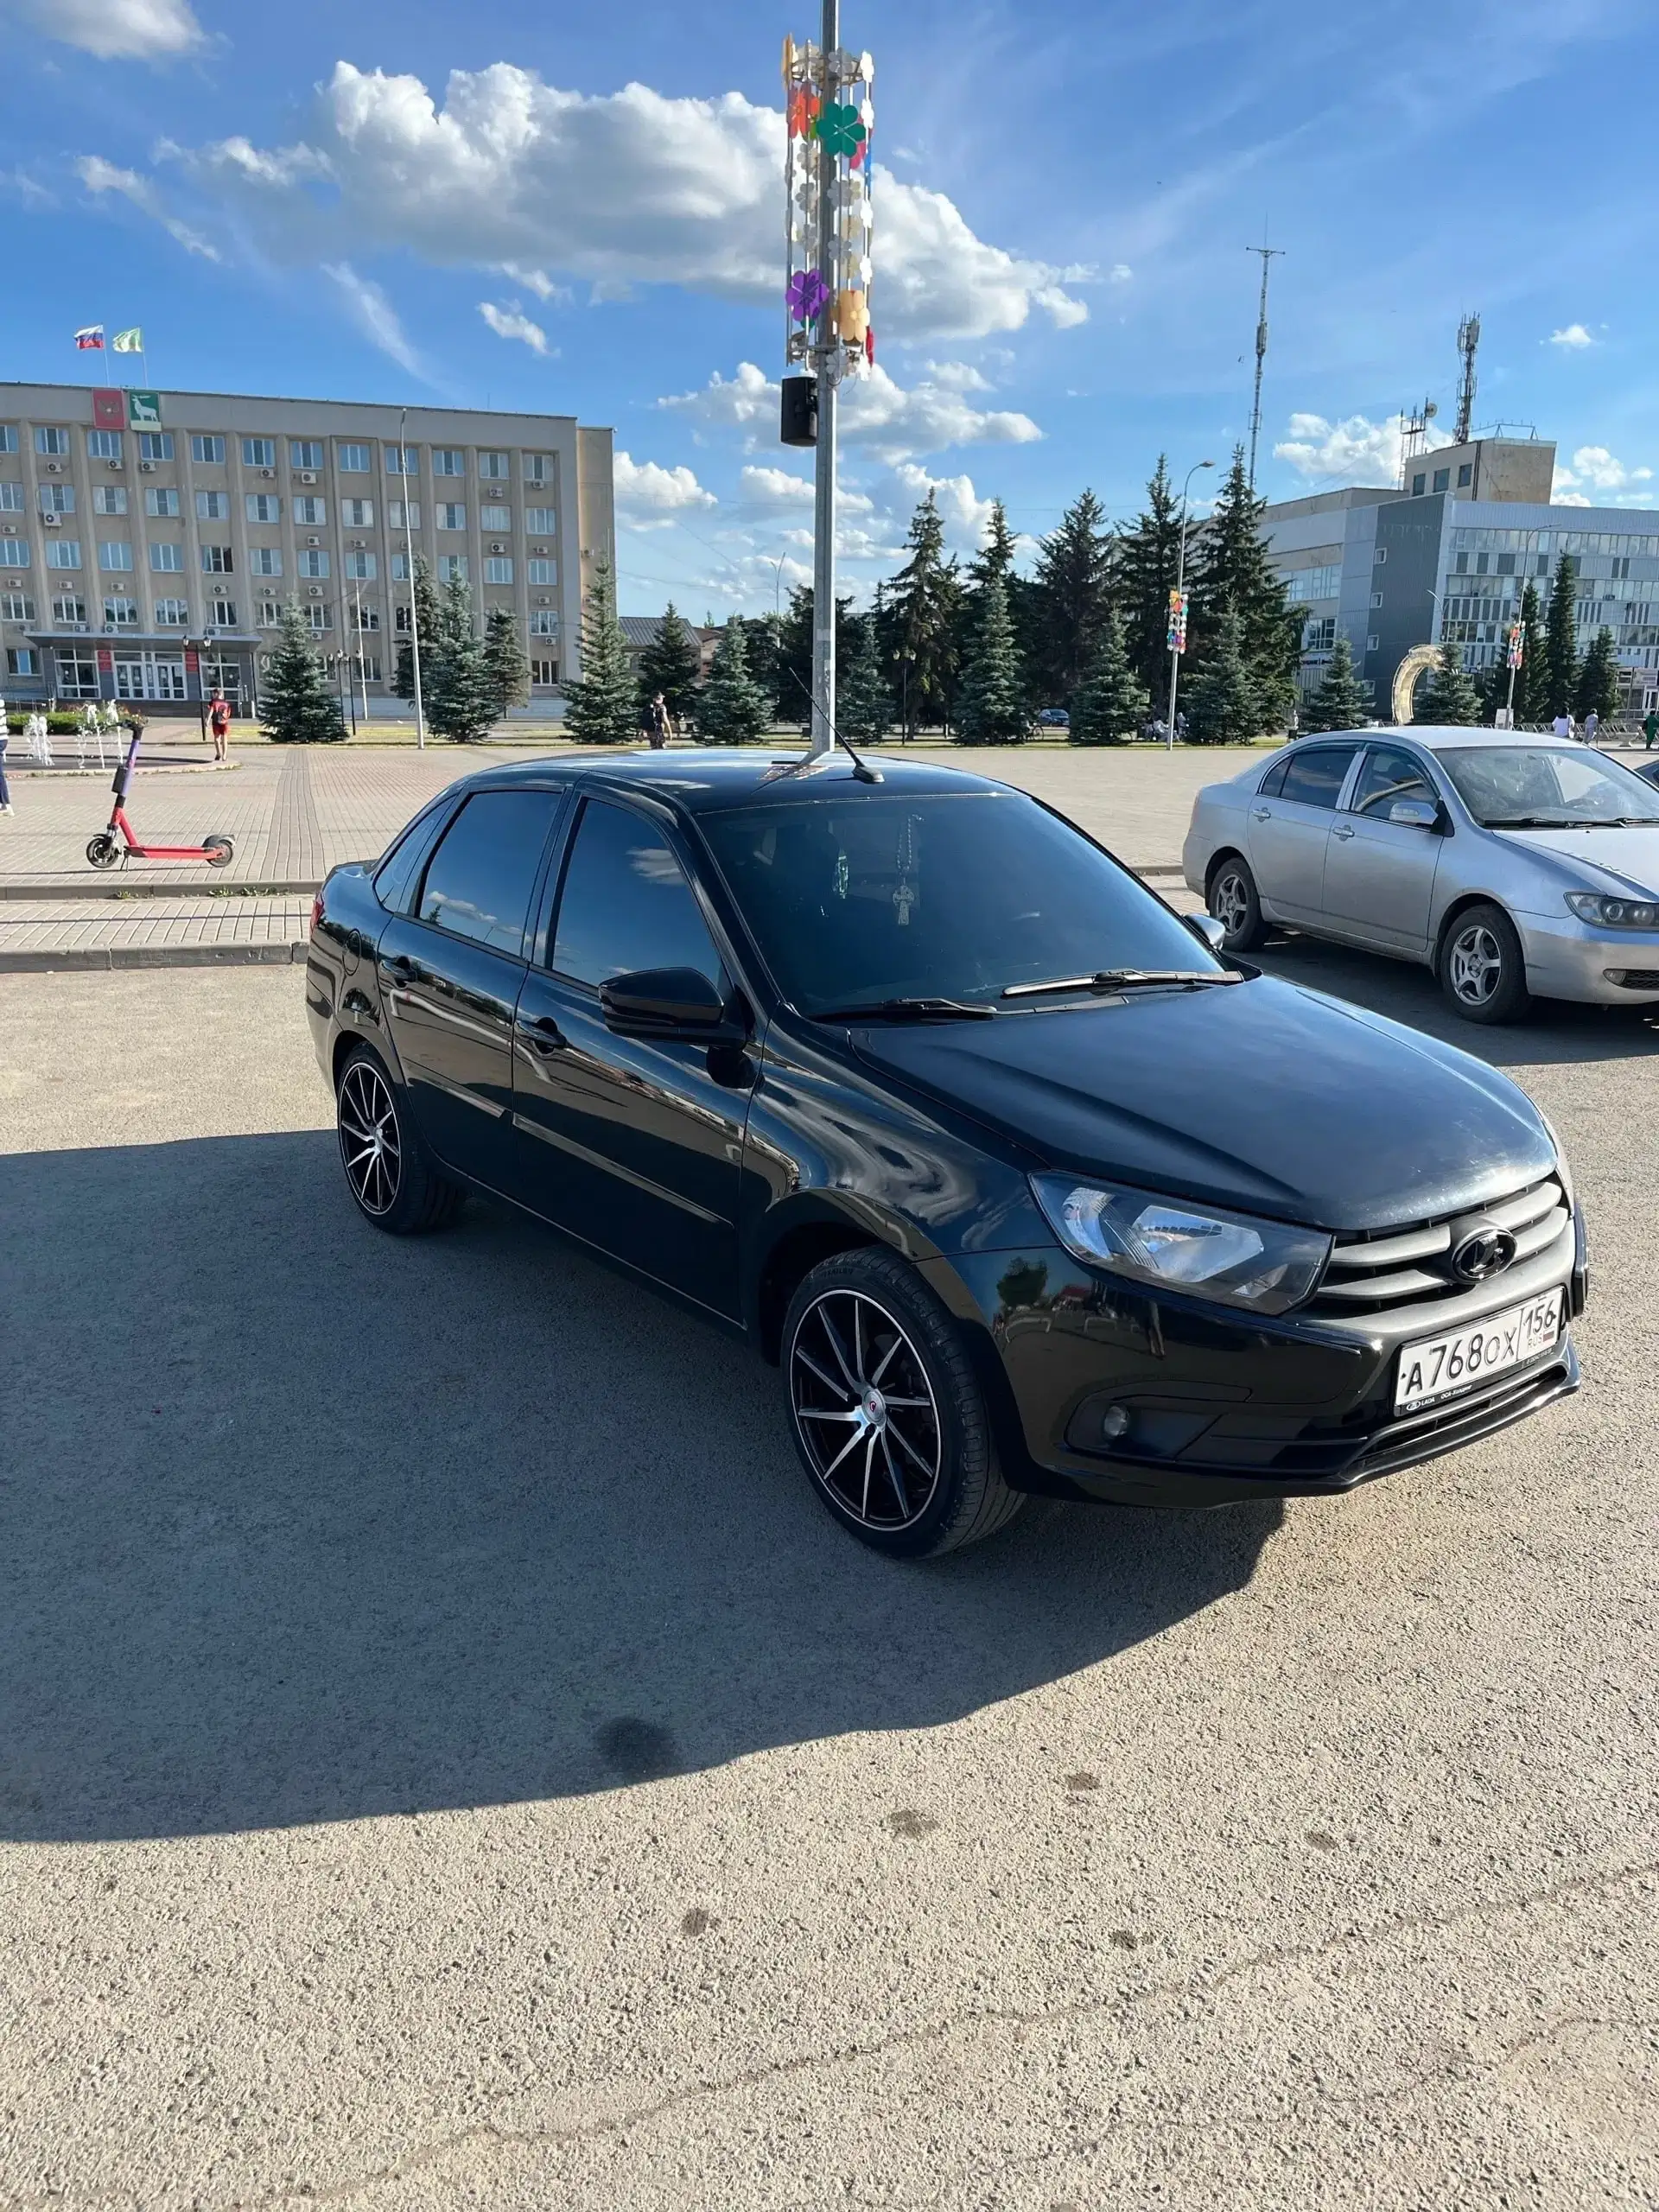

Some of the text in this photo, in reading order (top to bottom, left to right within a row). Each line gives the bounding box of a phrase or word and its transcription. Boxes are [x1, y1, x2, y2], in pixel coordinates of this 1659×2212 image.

[1523, 1300, 1554, 1338] 156
[1528, 1332, 1543, 1348] RUS
[1421, 1396, 1435, 1406] LADA
